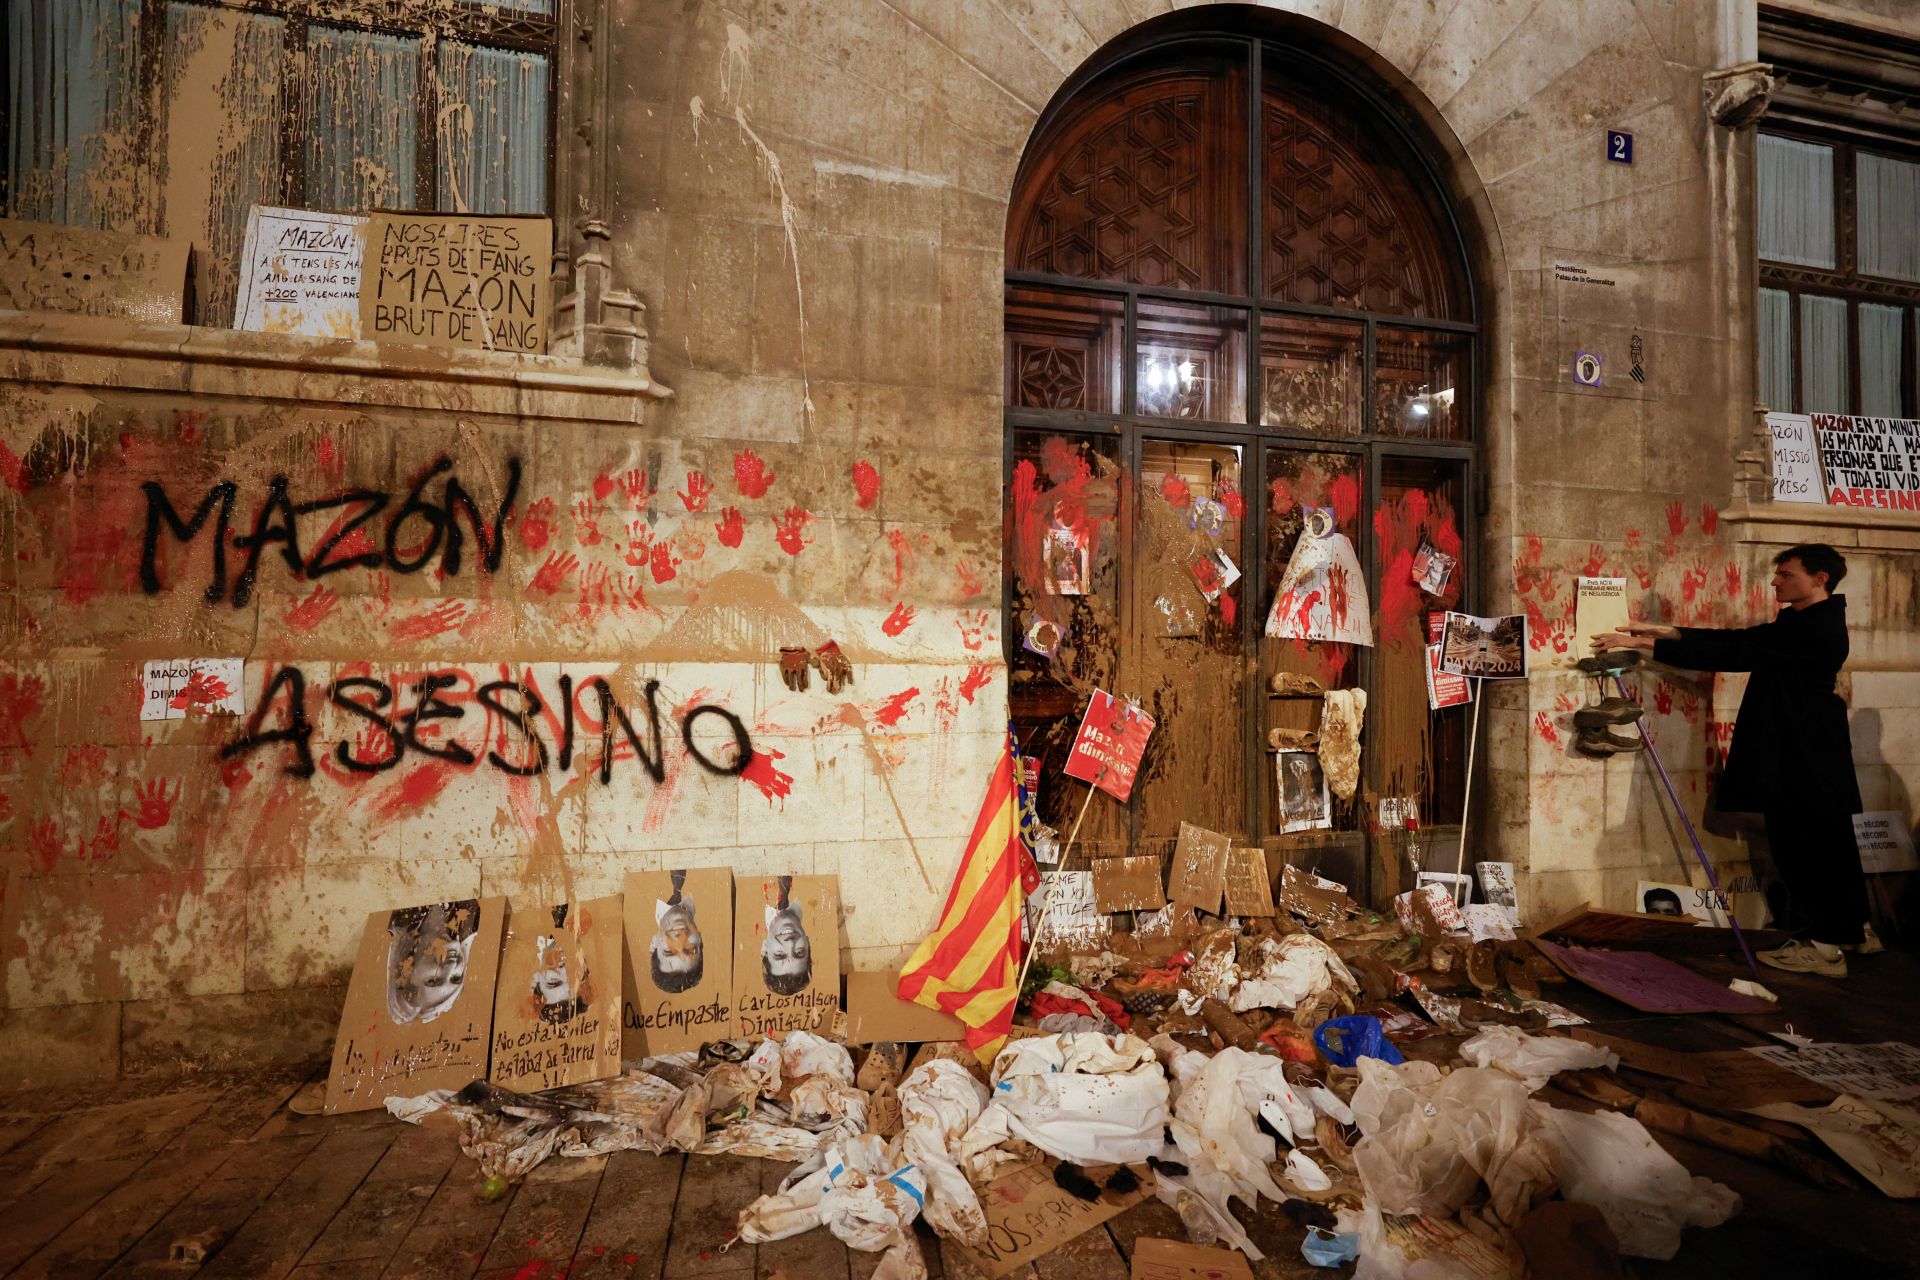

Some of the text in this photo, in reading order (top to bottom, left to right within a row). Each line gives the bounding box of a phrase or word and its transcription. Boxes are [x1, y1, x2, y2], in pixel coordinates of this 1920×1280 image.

[1614, 134, 1626, 159] 2
[291, 258, 320, 269] TENS
[344, 259, 362, 270] MA
[480, 249, 535, 277] FANG
[1555, 264, 1587, 274] Presidència
[309, 275, 338, 285] SANG
[342, 277, 357, 285] DE
[1555, 273, 1571, 281] Palau
[1586, 277, 1616, 287] Generalitat
[265, 288, 360, 299] +200 VALENCIANS
[378, 266, 536, 318] MAZÓN
[375, 304, 444, 337] BRUT
[449, 310, 476, 342] DE
[1857, 418, 1874, 434] EN
[1875, 419, 1886, 434] 10
[1889, 419, 1920, 436] MINUT
[1820, 432, 1834, 450] AS
[1837, 433, 1883, 453] MATADO
[1888, 435, 1898, 453] A
[1774, 449, 1811, 464] MISSIÓ
[1823, 450, 1877, 471] ERSONAS
[1880, 454, 1903, 472] QUE
[1787, 465, 1794, 477] A
[1841, 470, 1873, 488] TODA
[1875, 472, 1891, 490] SU
[140, 456, 521, 608] MAZÓN
[1489, 660, 1521, 673] 2024
[221, 665, 752, 785] ASESINO
[1083, 724, 1126, 756] Mazn
[1039, 872, 1079, 887] HAME
[495, 1031, 514, 1053] No
